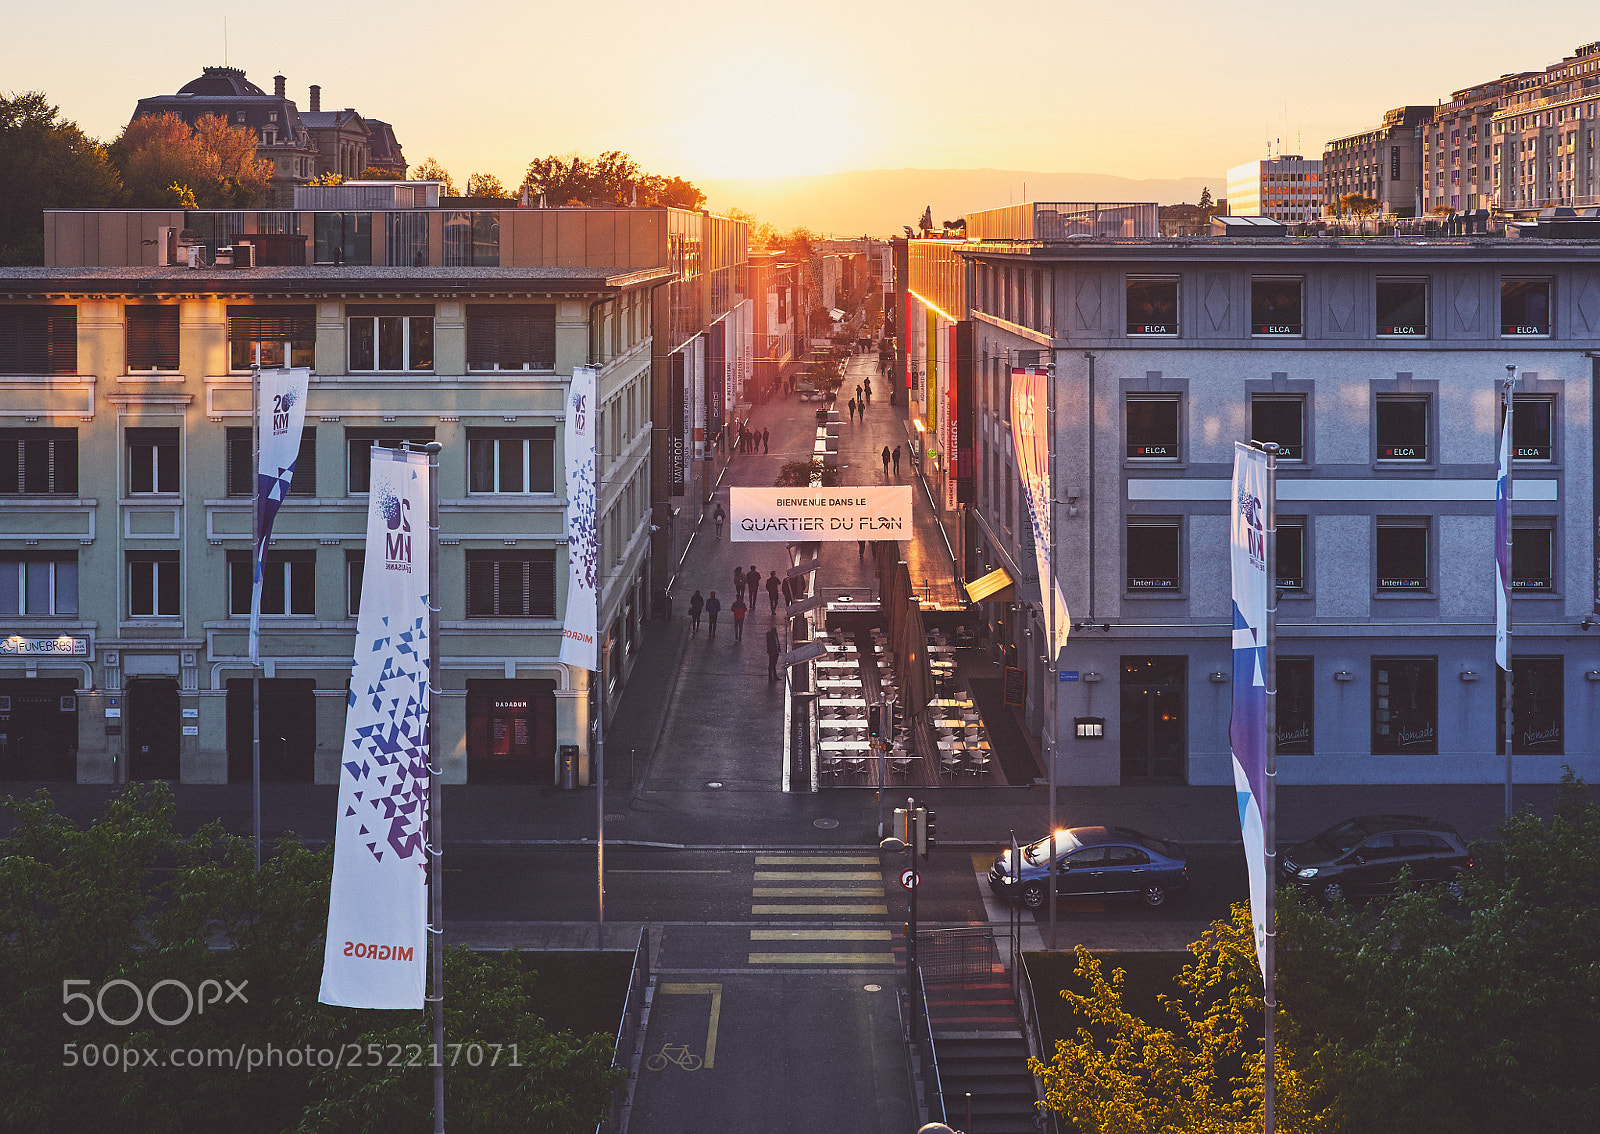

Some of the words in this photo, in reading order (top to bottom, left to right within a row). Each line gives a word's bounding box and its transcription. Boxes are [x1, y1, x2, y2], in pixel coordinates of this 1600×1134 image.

[1144, 325, 1166, 333] ELCA
[1517, 326, 1539, 334] ELCA
[273, 413, 289, 431] KM
[950, 420, 958, 460] MIGROS
[1145, 446, 1166, 454] ELCA
[1276, 448, 1290, 456] CA
[1393, 448, 1414, 456] ELCA
[1518, 448, 1539, 456] ELCA
[674, 437, 682, 484] NAVYBOOT
[776, 498, 826, 507] BIENVENUE
[829, 498, 853, 507] DANS
[856, 498, 867, 506] LE
[741, 517, 824, 531] QUARTIER
[830, 517, 853, 530] DU
[1398, 721, 1434, 746] Nomade
[1524, 721, 1560, 746] Nomade
